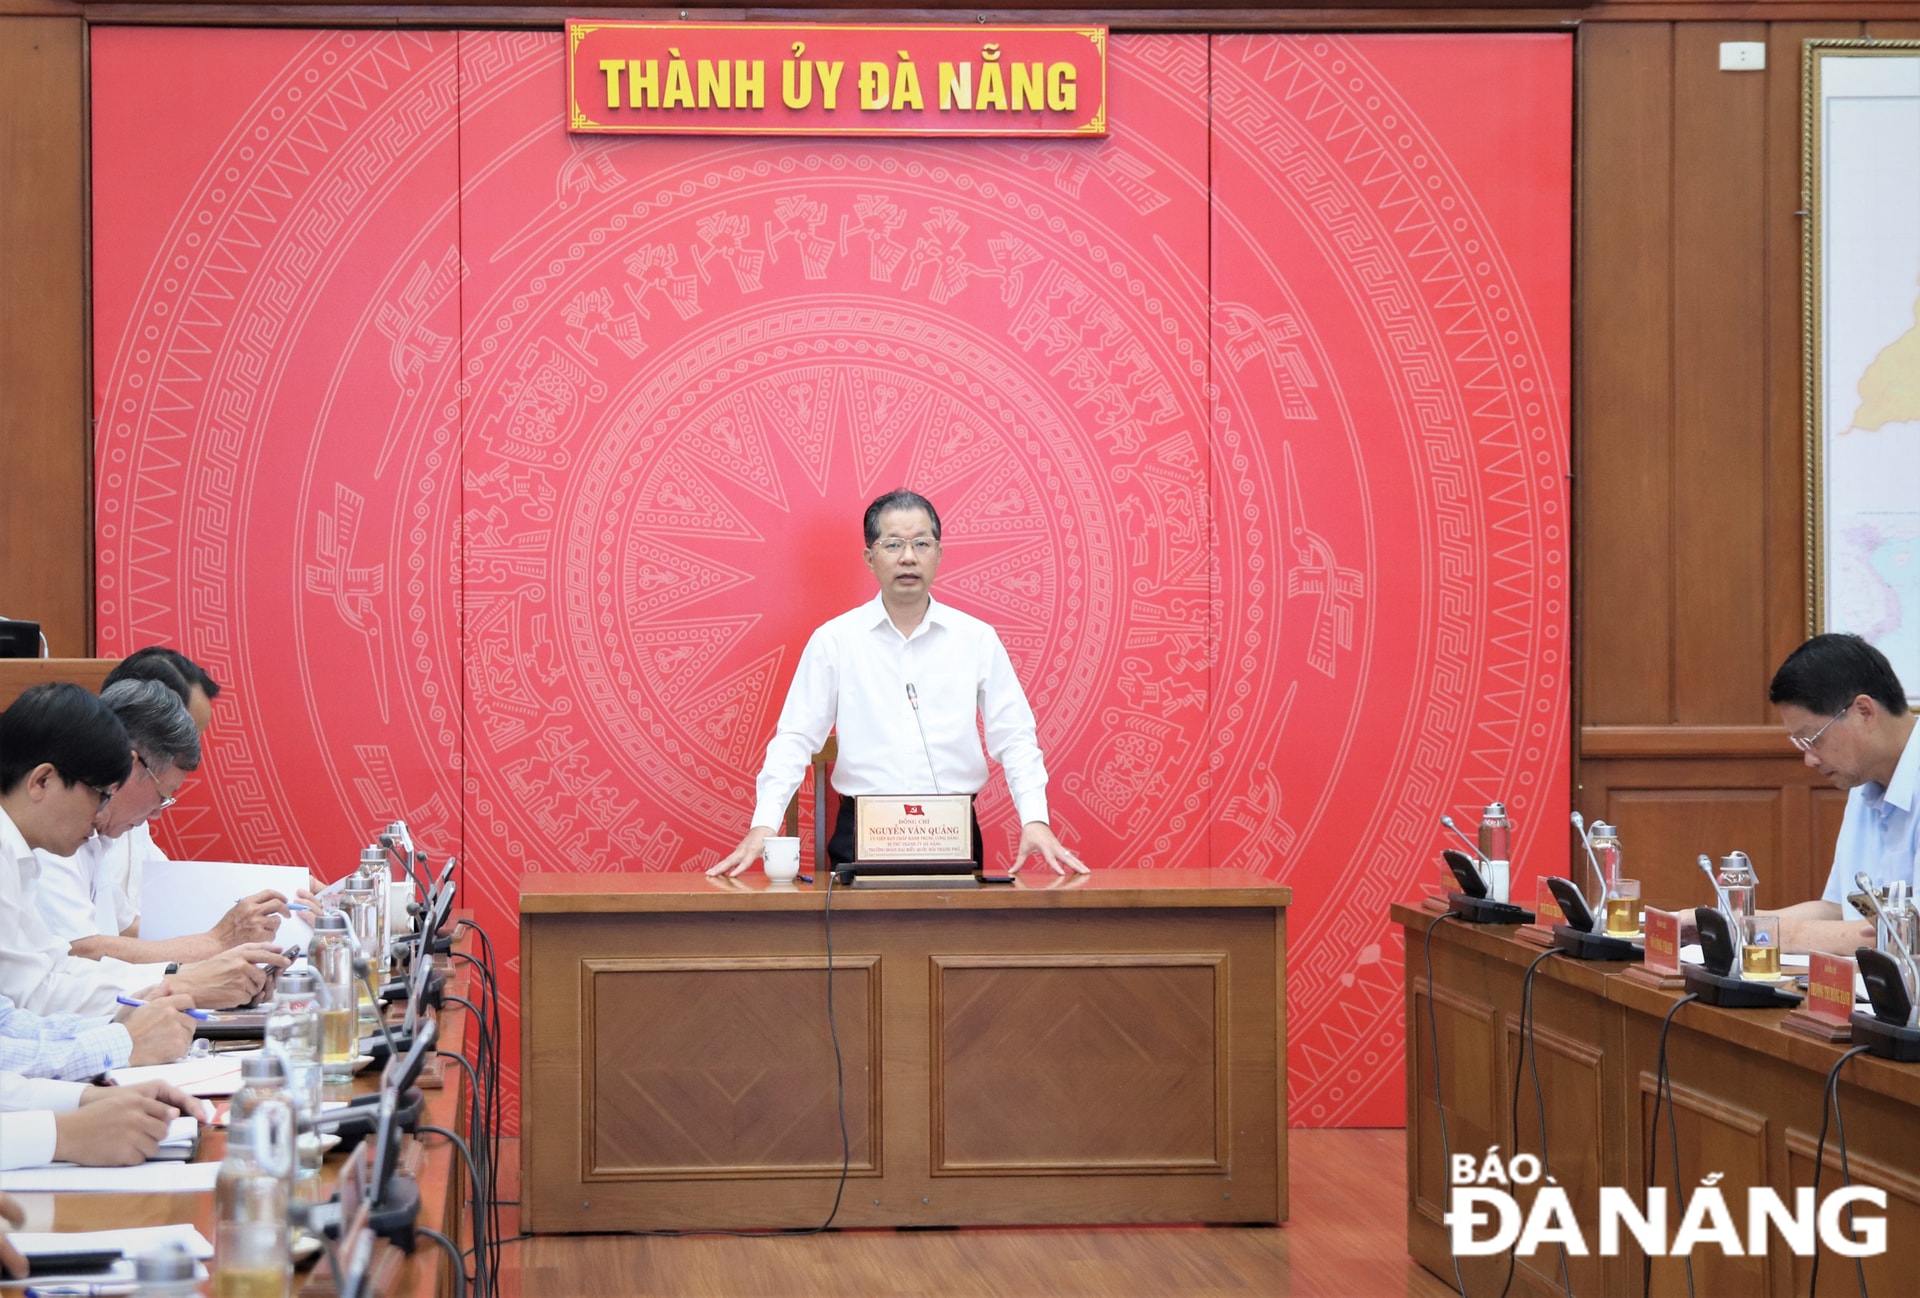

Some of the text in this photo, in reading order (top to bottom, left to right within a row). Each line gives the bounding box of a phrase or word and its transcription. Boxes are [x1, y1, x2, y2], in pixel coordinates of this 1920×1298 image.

[599, 42, 1078, 111] THÀNH ỦY ĐÀ NẴNG
